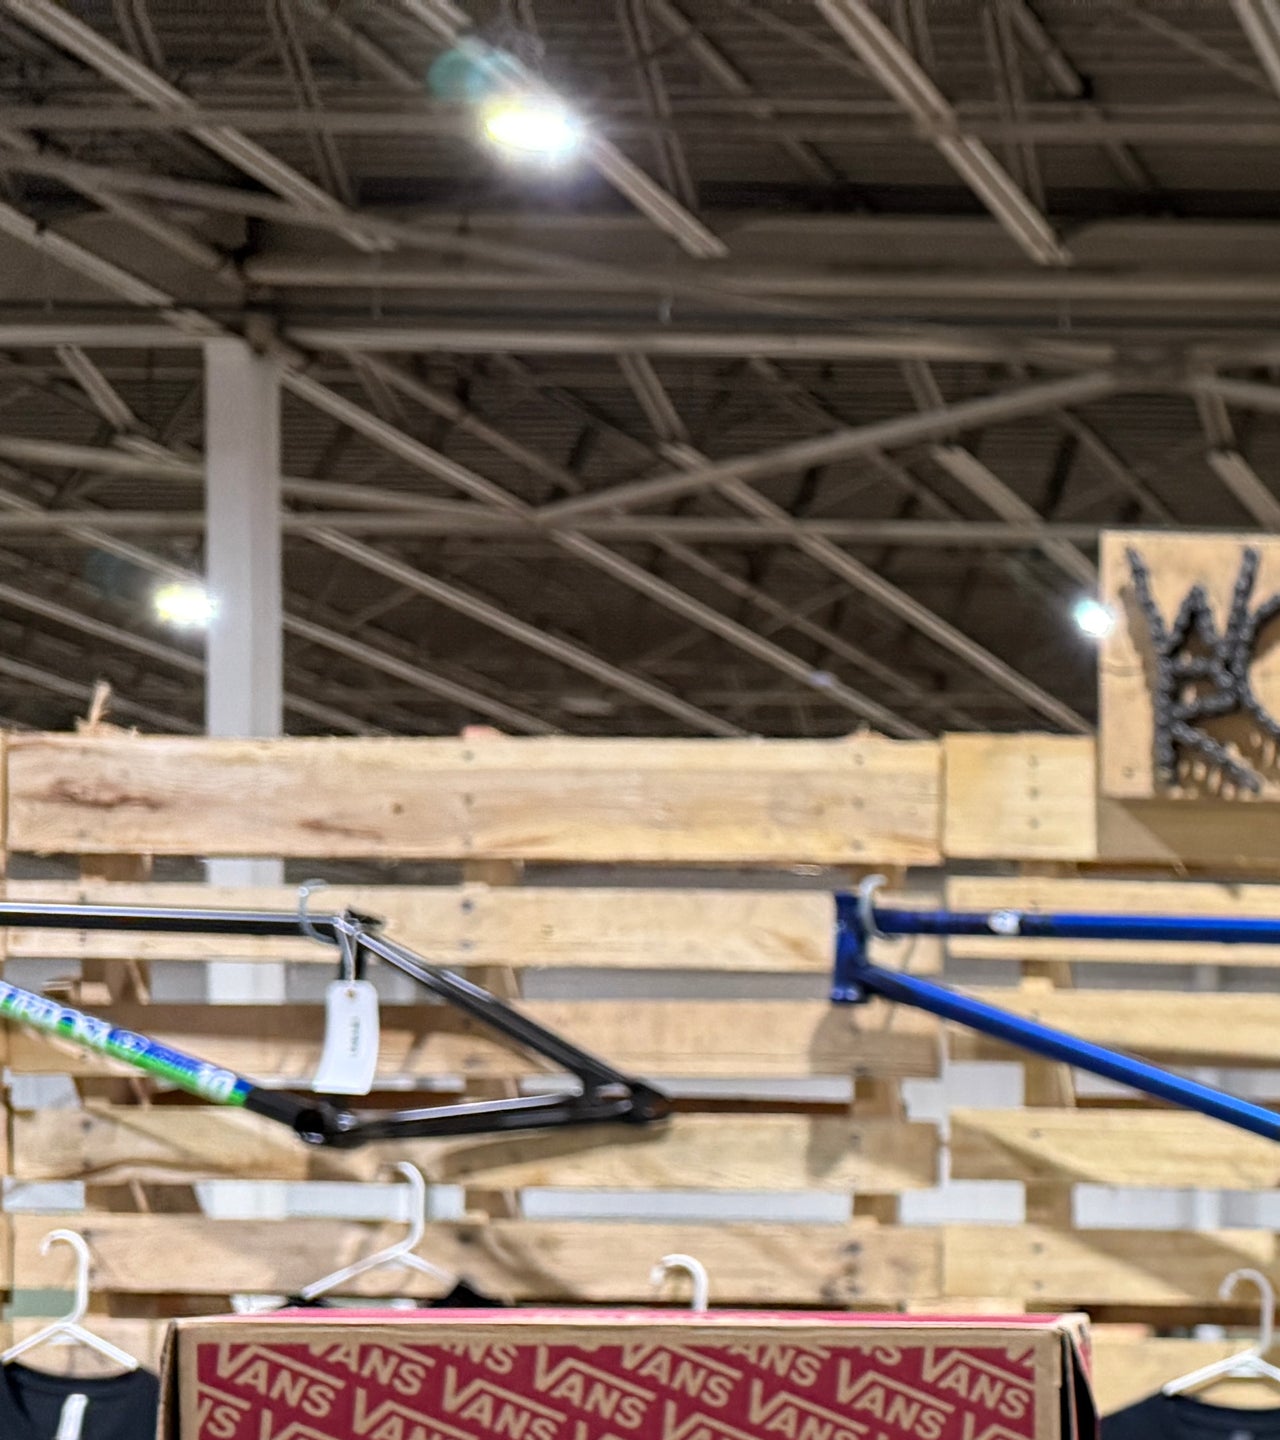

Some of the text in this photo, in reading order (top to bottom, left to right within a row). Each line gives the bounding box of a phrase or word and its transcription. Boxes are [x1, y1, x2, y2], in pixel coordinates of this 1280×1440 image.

[217, 1344, 344, 1416] VANS
[310, 1344, 436, 1394] ANS
[534, 1345, 656, 1428] VANS
[837, 1359, 953, 1439] VANS
[922, 1347, 1035, 1418] VANS
